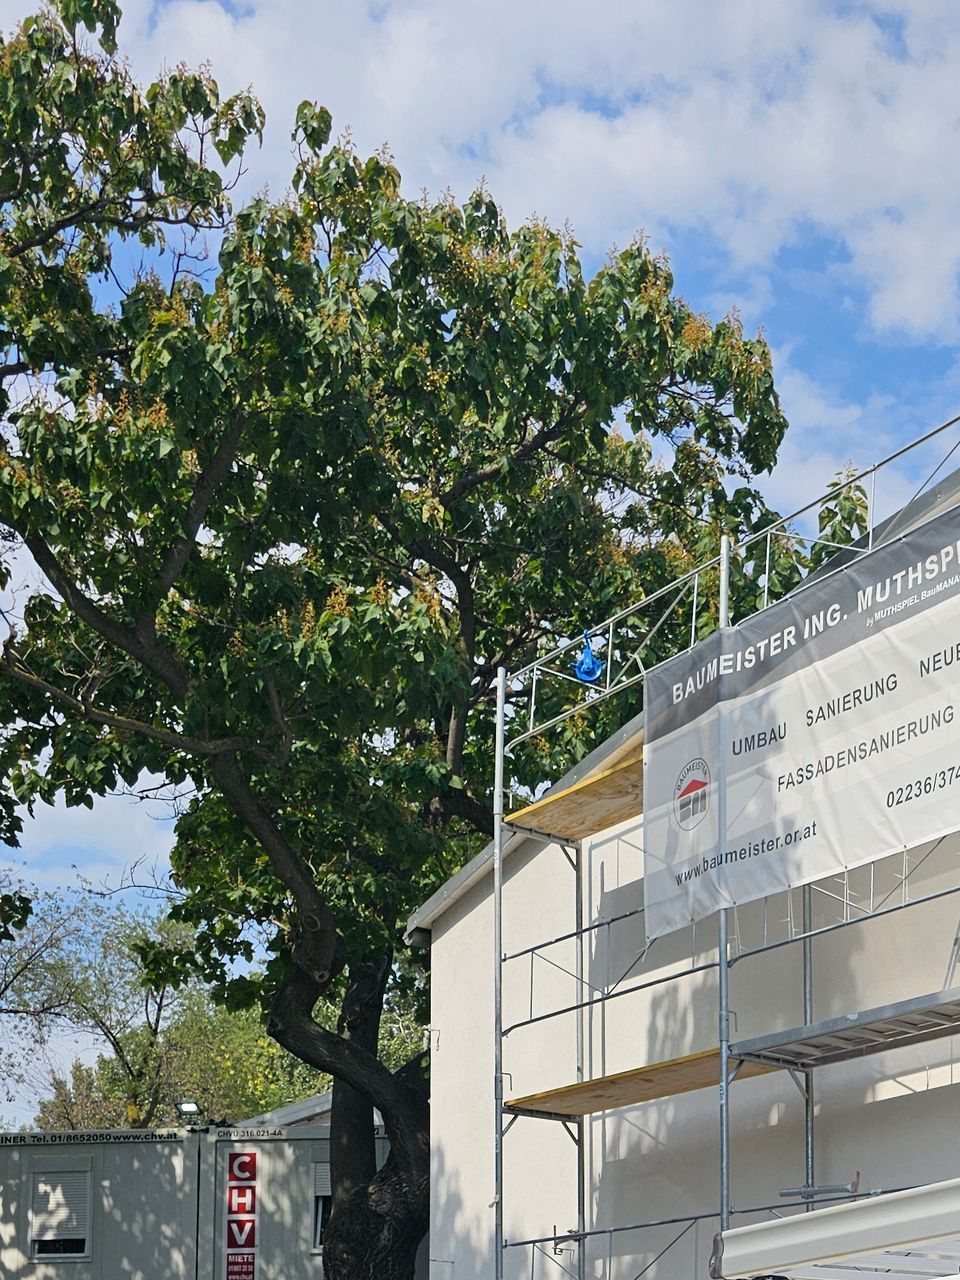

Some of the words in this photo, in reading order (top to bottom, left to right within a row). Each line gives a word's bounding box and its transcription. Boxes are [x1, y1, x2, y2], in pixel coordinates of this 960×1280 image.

[874, 595, 920, 621] MUTHSPIEL
[672, 625, 796, 705] BAUMEISTER
[803, 603, 848, 639] ING.
[732, 722, 787, 756] UMBAU
[805, 673, 898, 727] SANIERUNG
[777, 705, 955, 792] FASSADENSANIERUNG
[675, 821, 817, 886] www.baumeister.or.at
[51, 1133, 112, 1143] 01/8652050
[113, 1132, 178, 1141] www.chv.at
